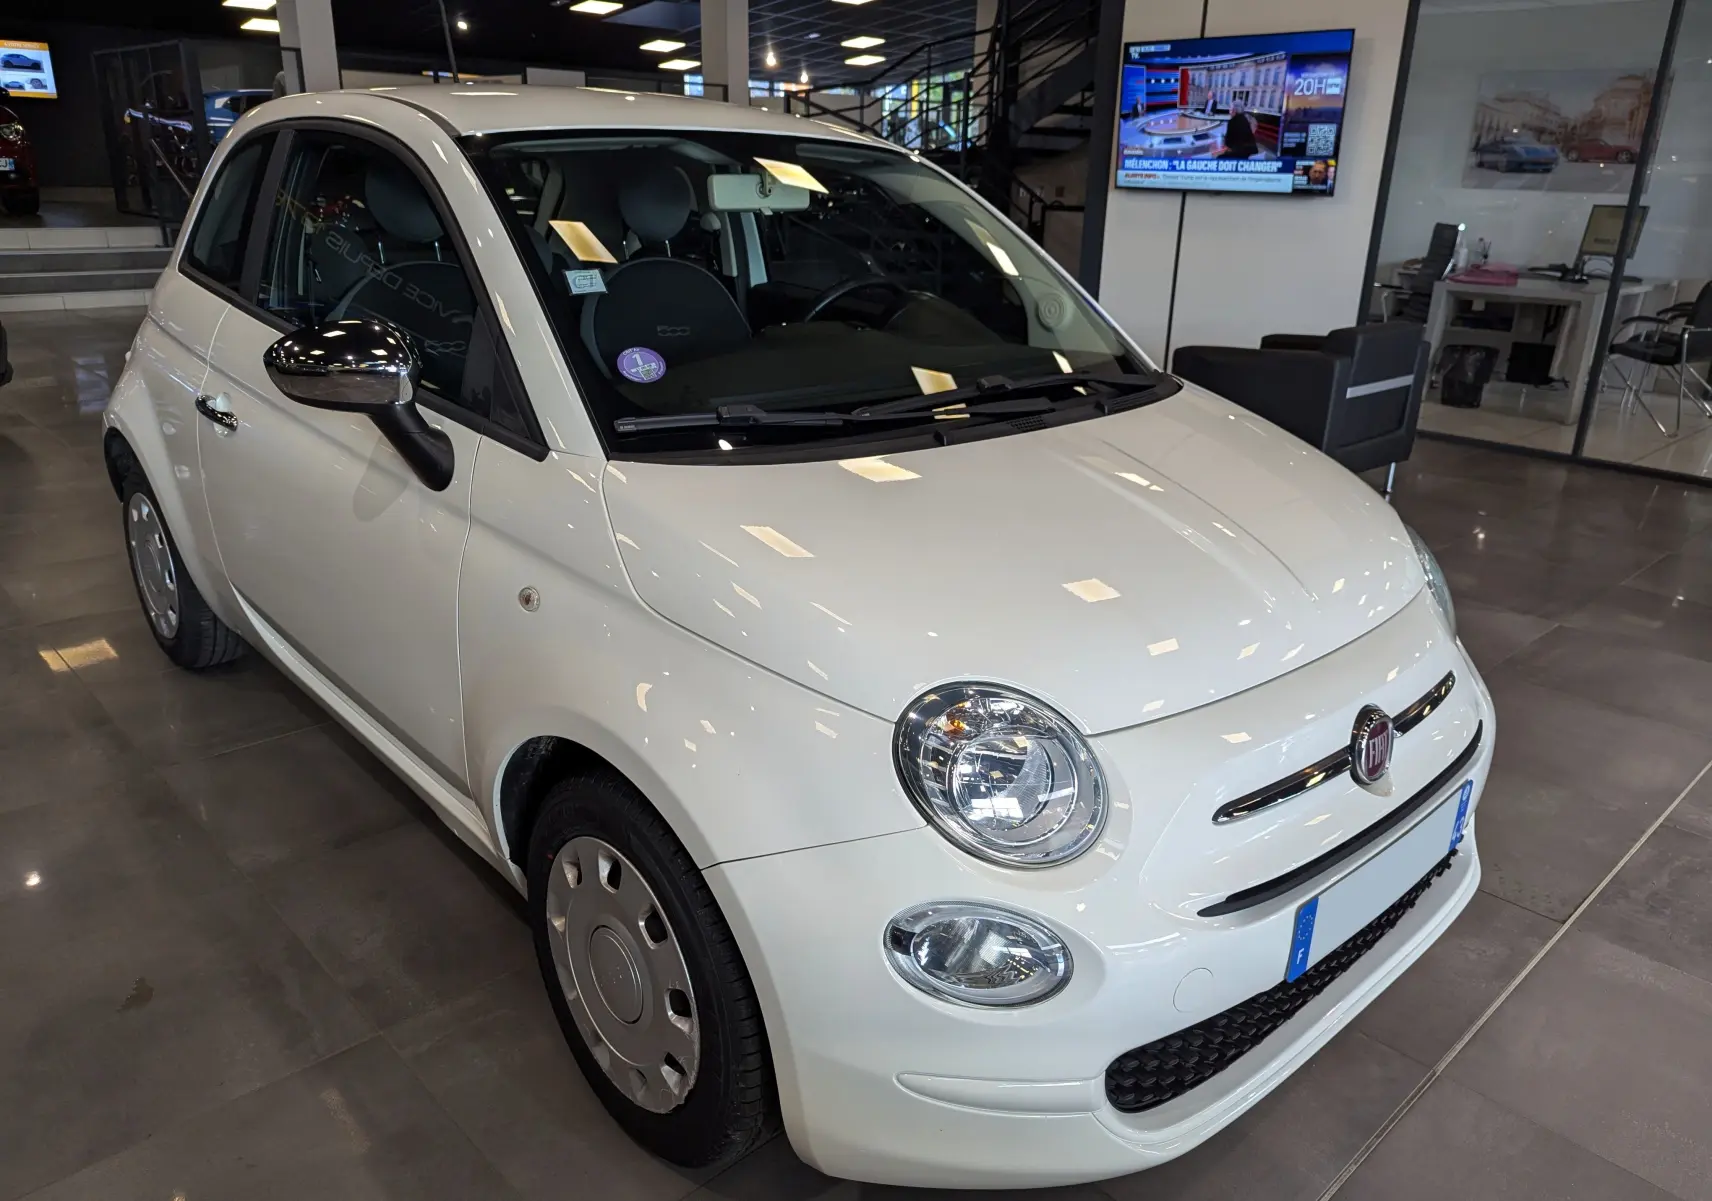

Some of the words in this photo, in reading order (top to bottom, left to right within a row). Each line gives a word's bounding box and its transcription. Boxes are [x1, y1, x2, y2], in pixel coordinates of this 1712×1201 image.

[1294, 78, 1326, 96] 20H
[1124, 157, 1168, 170] MÉLENCHON
[1187, 160, 1217, 171] GAUCHE
[1218, 160, 1237, 172] DOIT
[657, 325, 690, 336] 500
[632, 353, 643, 366] 1
[1368, 729, 1388, 769] FIAT
[1296, 948, 1304, 964] F
